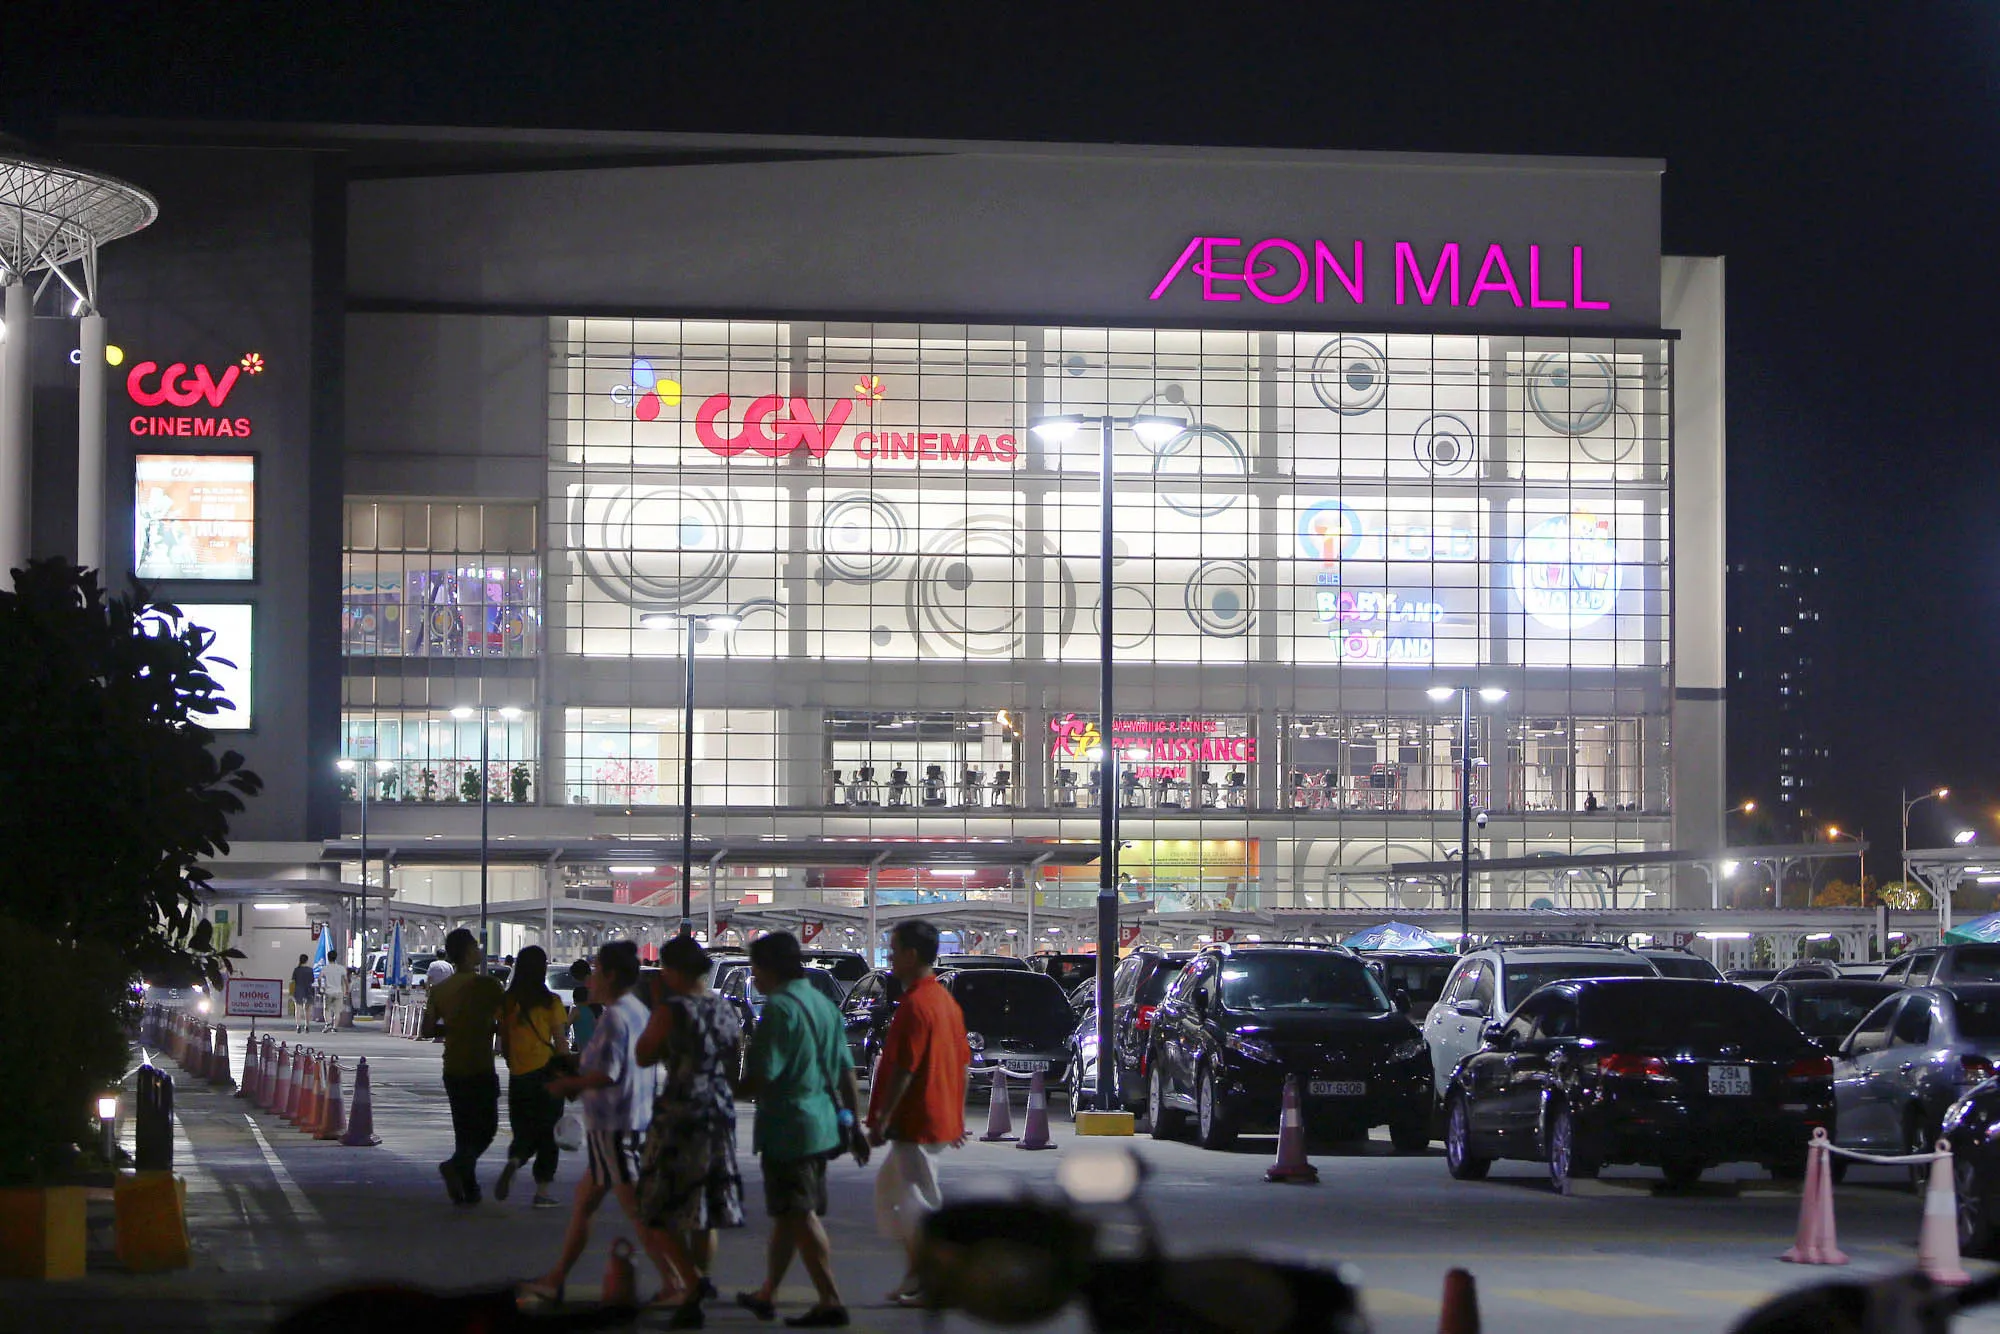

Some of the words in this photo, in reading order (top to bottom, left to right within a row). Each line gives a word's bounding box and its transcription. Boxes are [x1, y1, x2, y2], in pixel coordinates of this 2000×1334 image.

[1395, 241, 1610, 310] MALL
[127, 361, 240, 408] CGV
[129, 415, 251, 438] CINEMAS
[695, 393, 853, 458] CGV
[854, 431, 1018, 462] CINEMAS
[1134, 765, 1187, 779] JAPAN
[239, 990, 270, 1000] KHÔNG
[1719, 1067, 1741, 1080] 29A
